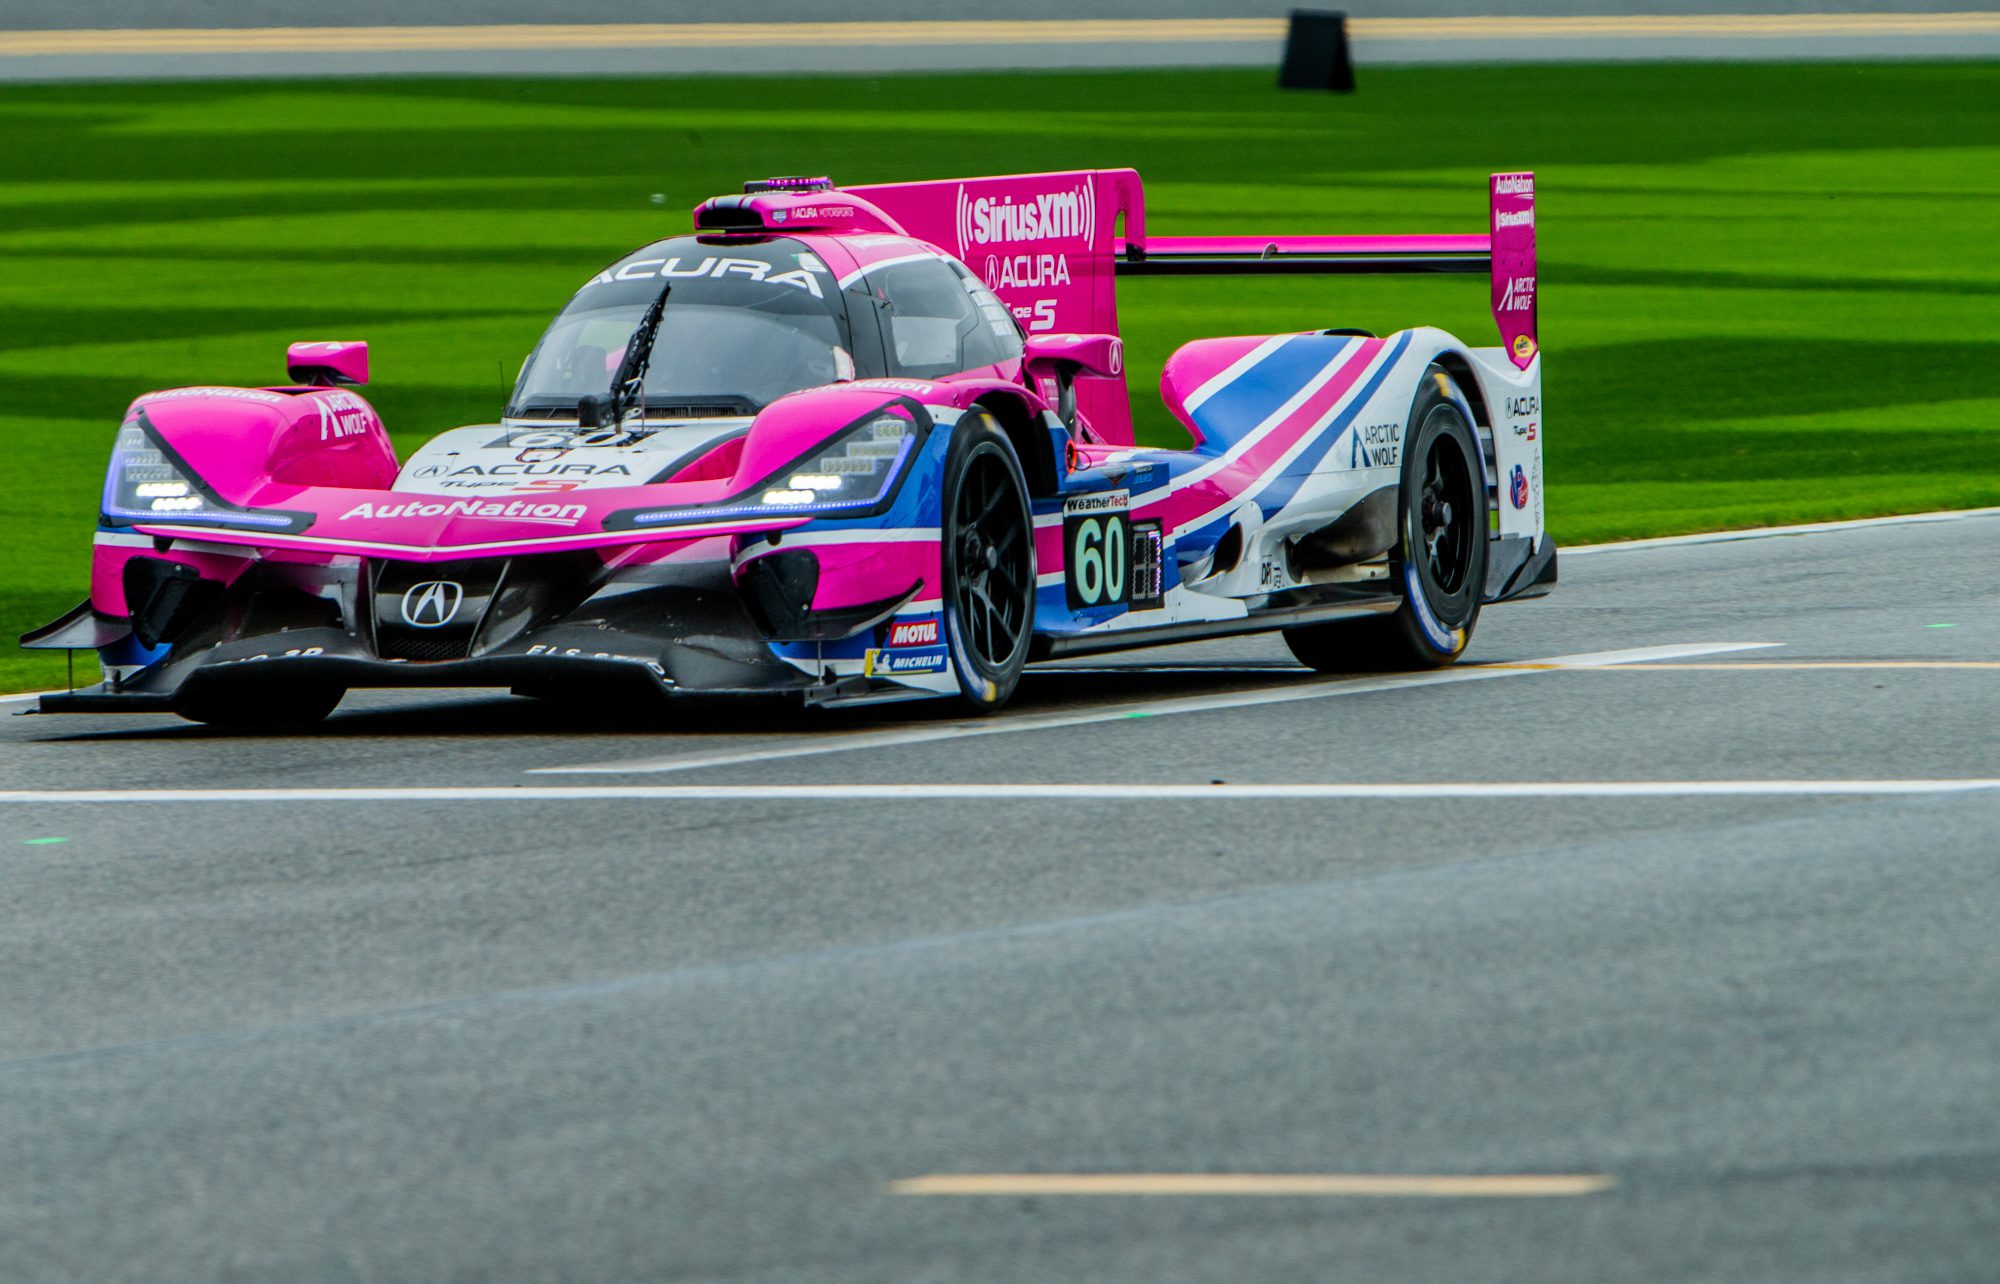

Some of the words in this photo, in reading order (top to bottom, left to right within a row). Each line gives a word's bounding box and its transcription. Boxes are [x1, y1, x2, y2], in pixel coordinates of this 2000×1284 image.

[1496, 176, 1533, 194] AutoNation
[798, 208, 818, 219] ACURA
[1000, 253, 1071, 289] ACURA
[1514, 277, 1535, 293] ARCTIC
[1514, 295, 1532, 311] WOLF
[1030, 299, 1058, 331] S
[341, 413, 367, 436] WOLF
[1365, 423, 1400, 445] ARCTIC
[1527, 422, 1537, 441] S
[1371, 446, 1398, 467] WOLF
[448, 464, 631, 477] ACURA
[339, 500, 588, 522] AutoNation
[1075, 516, 1125, 605] 60
[893, 622, 938, 645] MOTUL
[893, 654, 944, 669] MICHELIN
